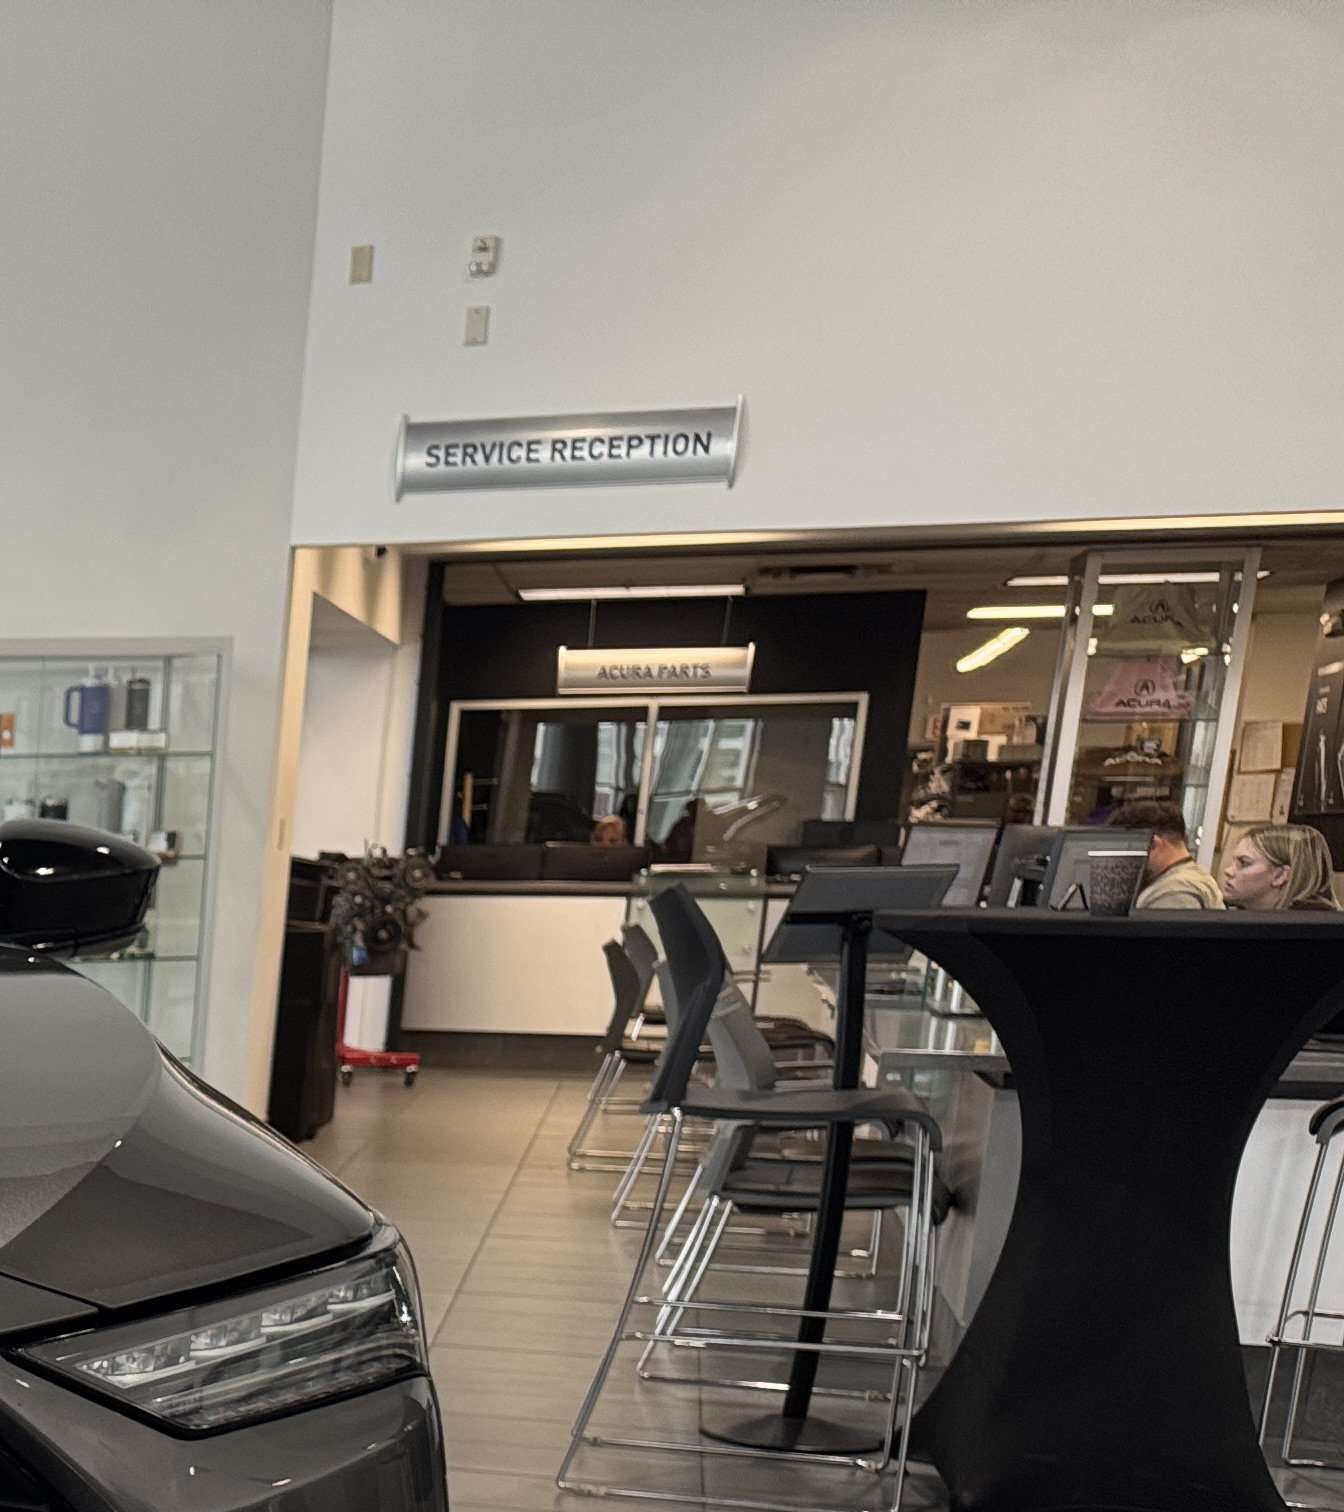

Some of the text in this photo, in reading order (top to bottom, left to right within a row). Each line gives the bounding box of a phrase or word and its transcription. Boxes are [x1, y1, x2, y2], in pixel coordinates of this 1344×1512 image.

[424, 430, 713, 468] SERVICE RECEPTION
[597, 662, 712, 681] ACURA PARTS
[1115, 698, 1172, 710] ACURA
